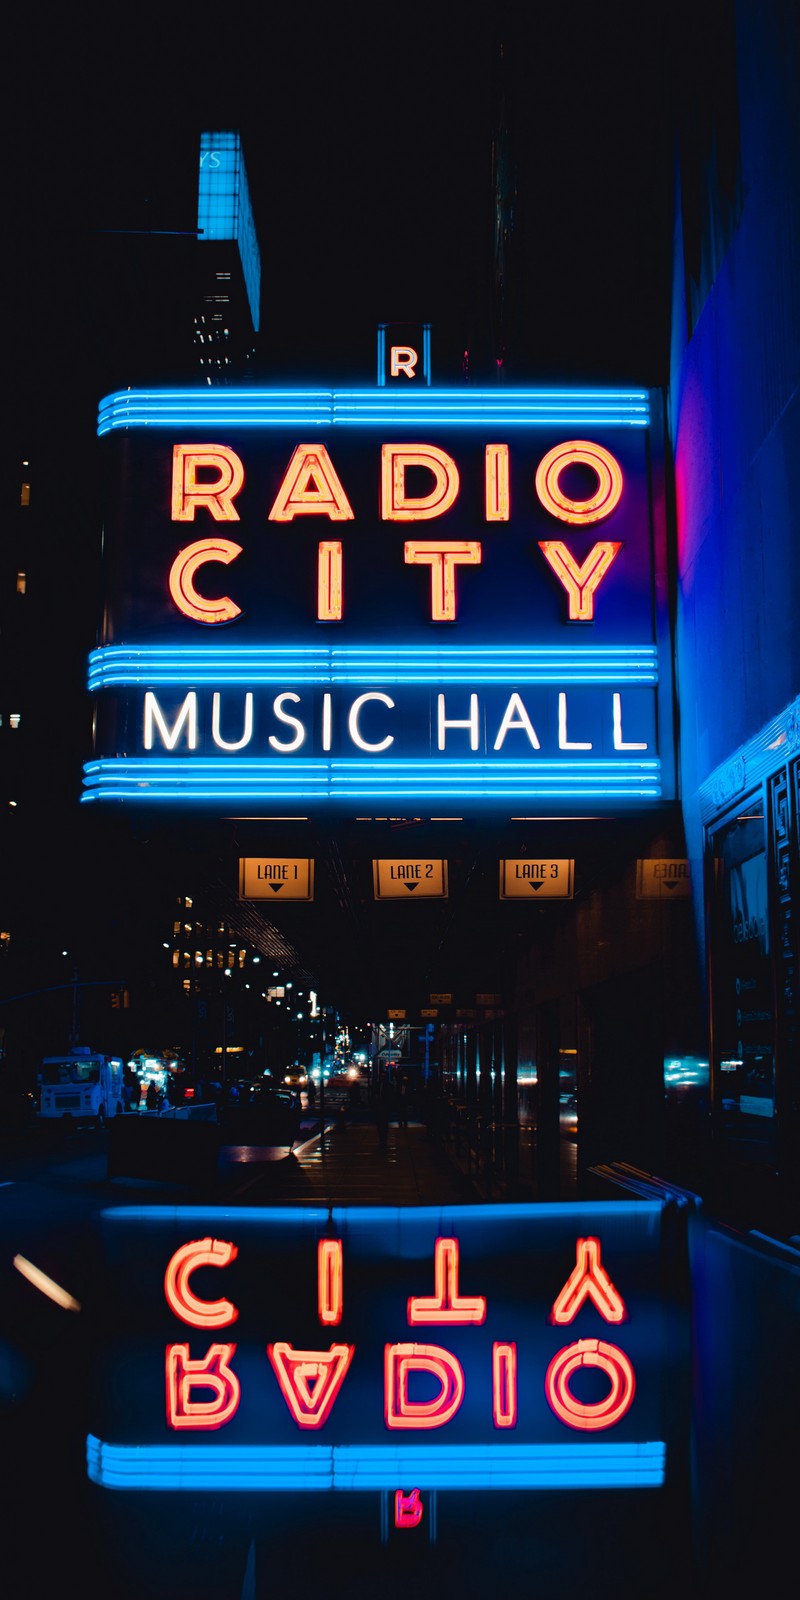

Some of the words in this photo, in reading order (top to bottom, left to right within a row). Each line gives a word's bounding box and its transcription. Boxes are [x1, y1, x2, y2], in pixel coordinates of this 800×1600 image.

[391, 346, 418, 378] R
[171, 440, 624, 525] RADIO
[169, 538, 622, 623] CITY
[143, 687, 395, 753] MUSIC
[437, 693, 648, 751] HALL
[257, 864, 289, 880] LANE
[293, 865, 298, 880] 1
[390, 864, 422, 880] LANE
[425, 864, 434, 879] 2
[515, 864, 546, 880] LANE
[550, 864, 559, 879] 3
